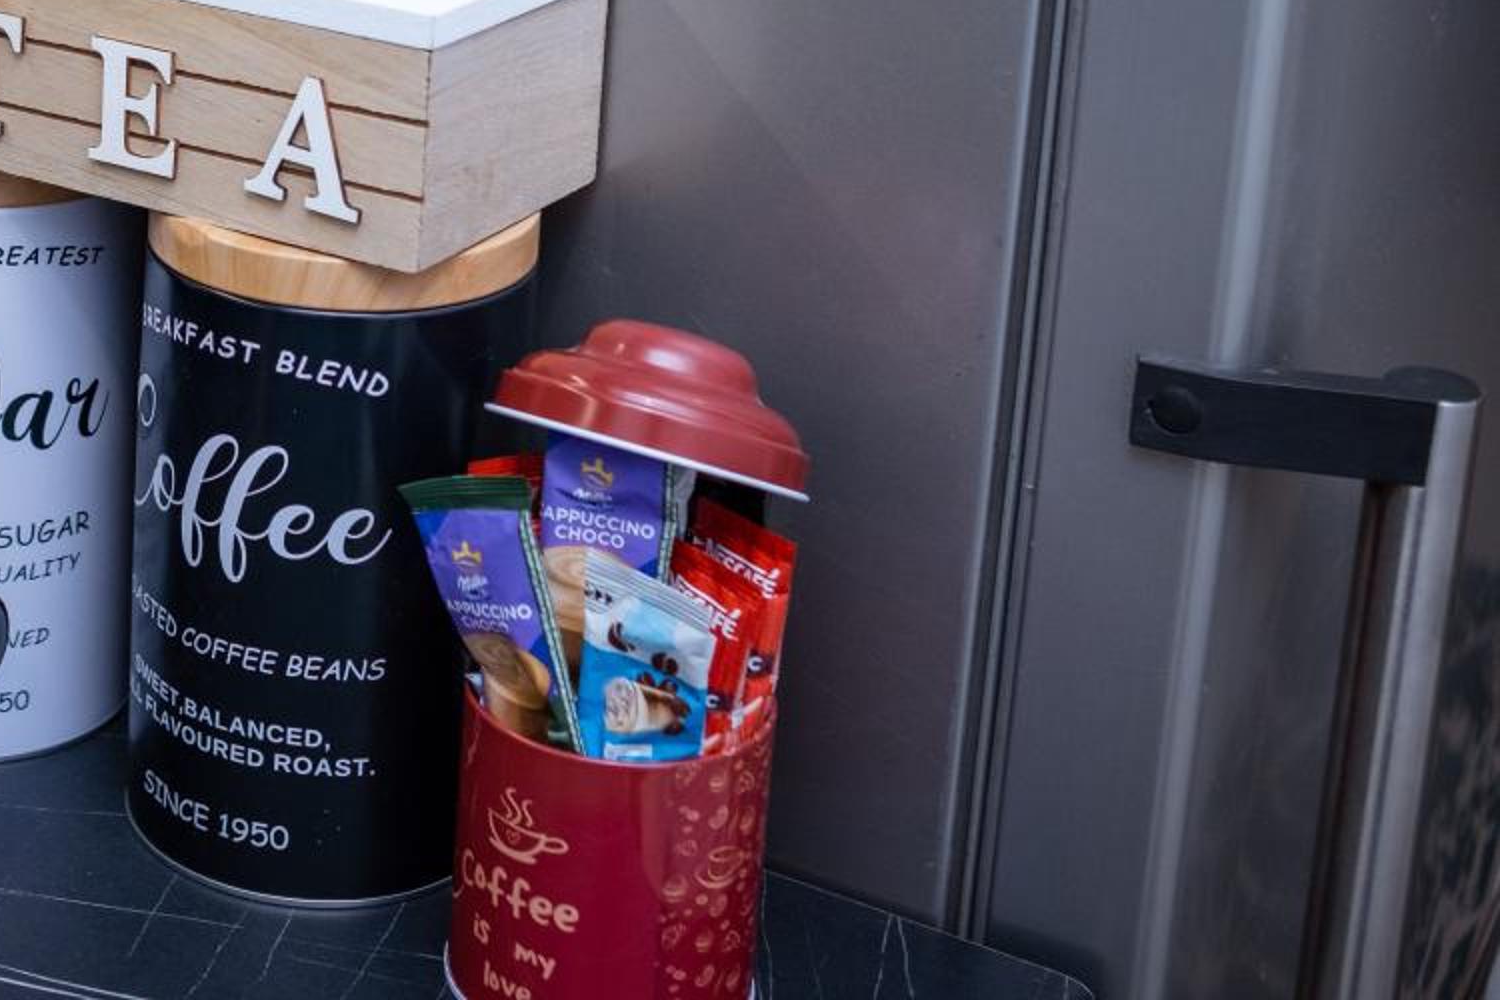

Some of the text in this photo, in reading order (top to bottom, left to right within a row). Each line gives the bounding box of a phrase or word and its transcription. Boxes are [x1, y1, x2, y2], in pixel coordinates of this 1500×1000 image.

[275, 350, 389, 397] BLEND
[135, 373, 393, 583] offee
[543, 505, 656, 539] APPUCCINO
[554, 524, 625, 548] CHOCO
[182, 627, 279, 675] COFFEE
[285, 655, 387, 682] BEANS
[145, 694, 264, 768] FLAVOURED
[273, 756, 377, 778] ROAST.
[143, 769, 290, 851] SINCE 1950
[461, 847, 580, 934] Coffee
[473, 912, 557, 981] is my
[483, 960, 532, 1000] love
